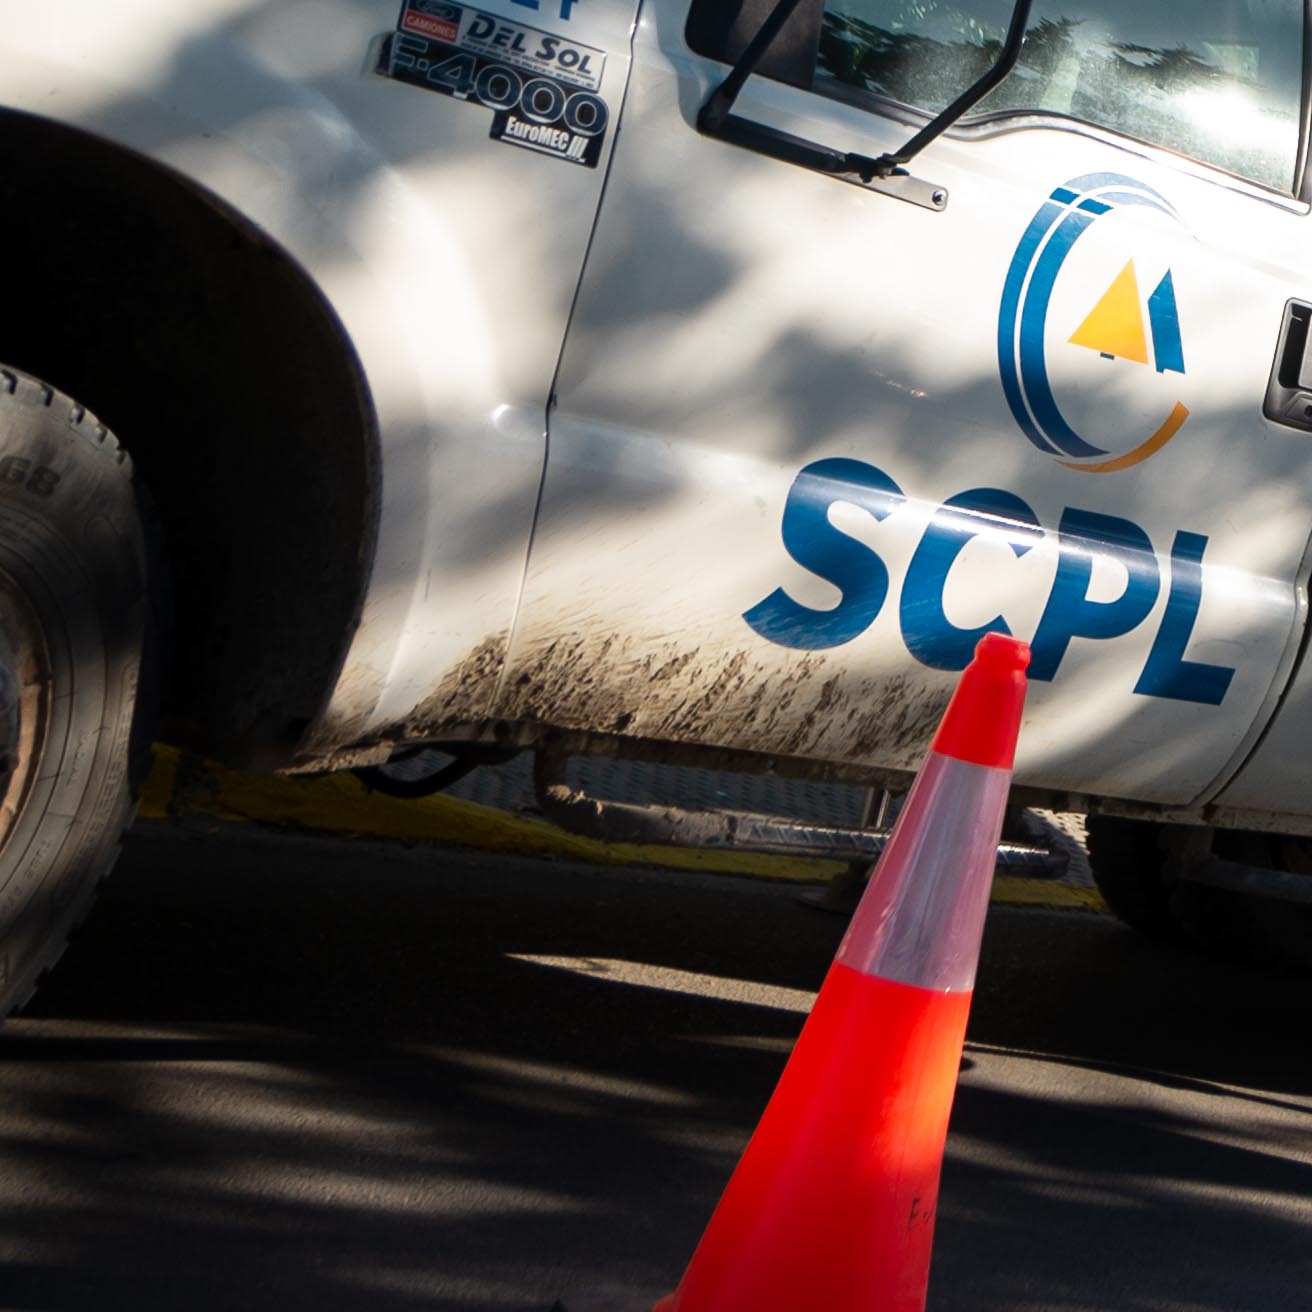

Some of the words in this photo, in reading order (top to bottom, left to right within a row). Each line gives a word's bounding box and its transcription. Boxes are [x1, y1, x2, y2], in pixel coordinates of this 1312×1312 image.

[405, 14, 457, 39] CAMIONES
[467, 14, 526, 53] DEL
[535, 37, 592, 75] SOL
[505, 116, 569, 151] EuroMEC
[742, 457, 1236, 706] SCPL
